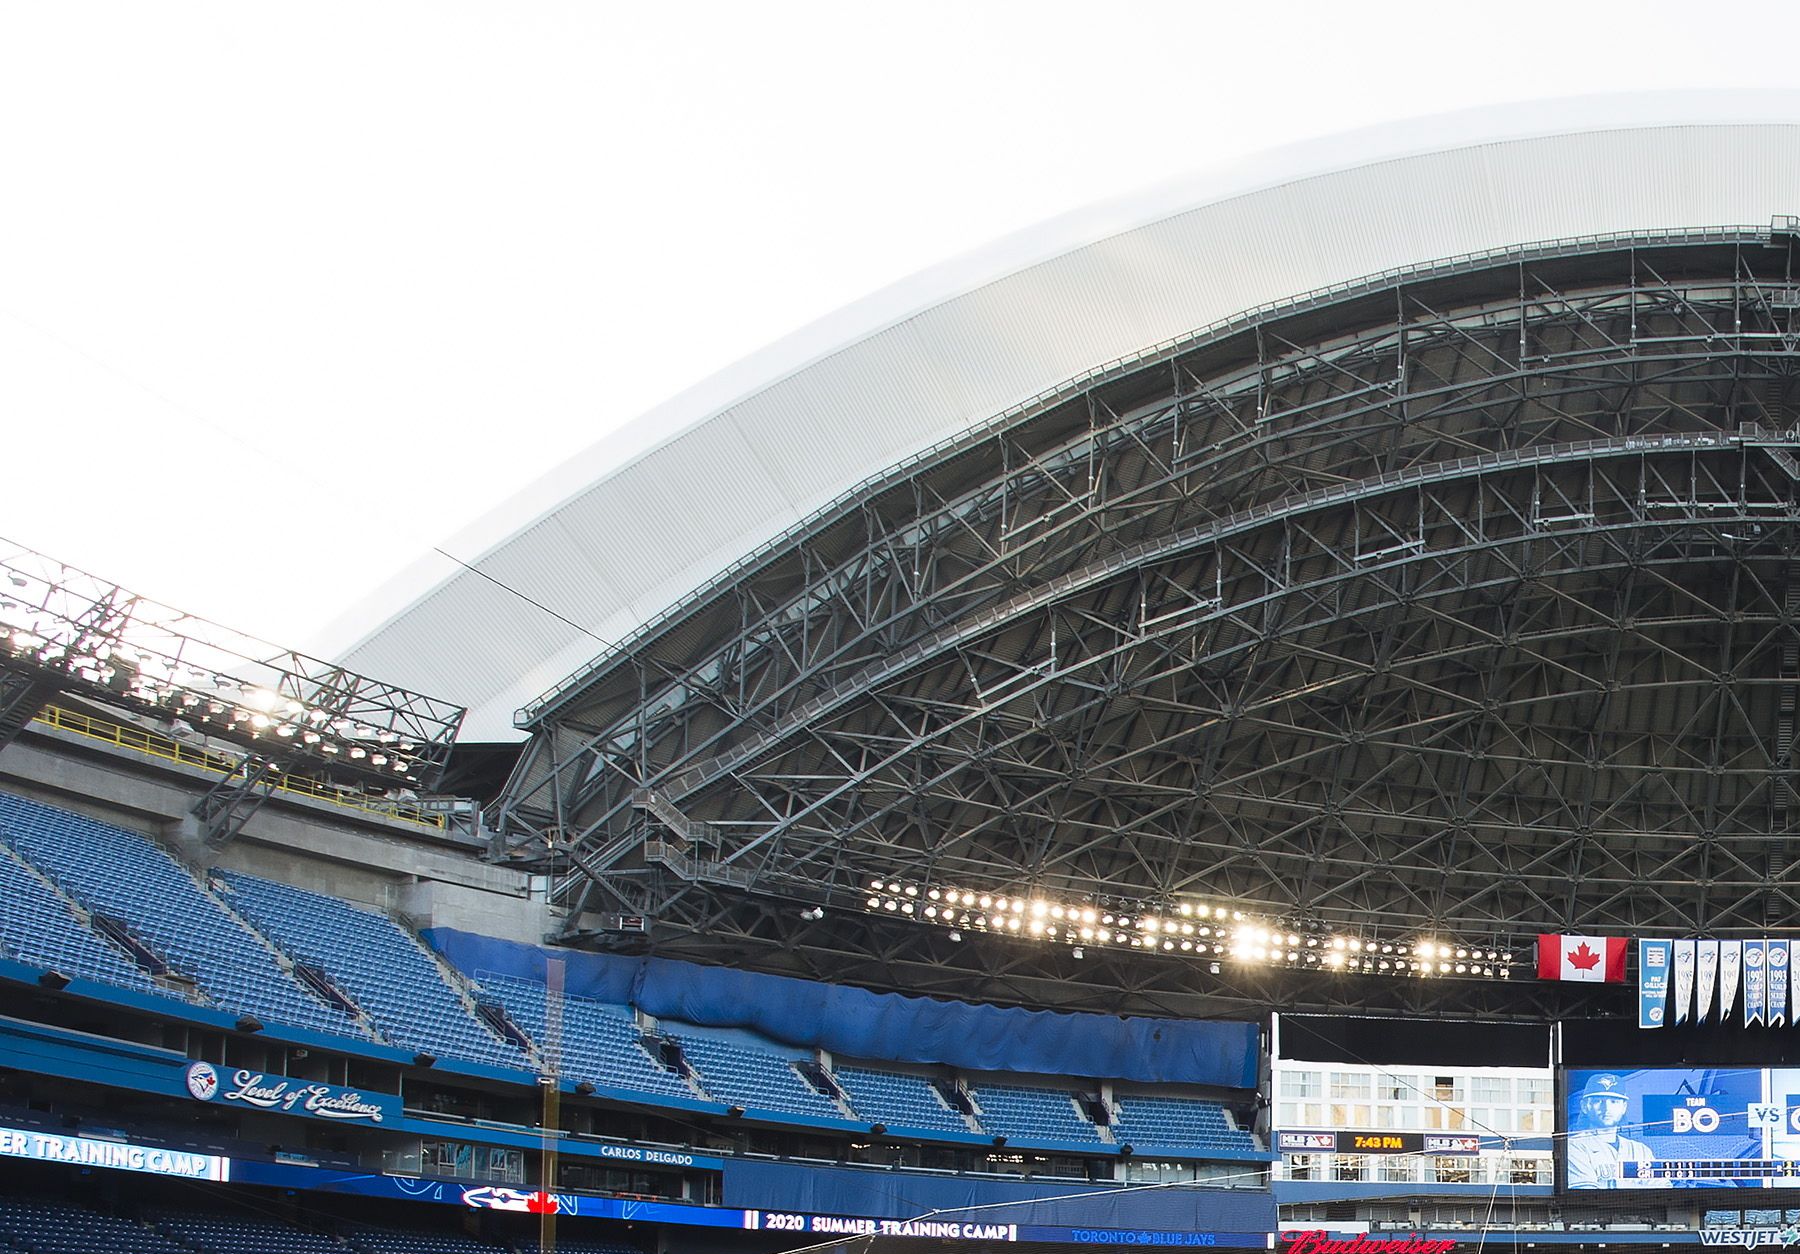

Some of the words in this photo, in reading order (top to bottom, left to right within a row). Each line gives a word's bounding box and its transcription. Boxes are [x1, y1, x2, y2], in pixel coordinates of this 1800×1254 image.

[1769, 970, 1787, 982] 1993
[225, 1069, 289, 1107] Level
[283, 1086, 308, 1110] of
[304, 1084, 384, 1123] Excellence
[1685, 1097, 1707, 1107] TEAM
[1672, 1107, 1721, 1133] BO
[1754, 1107, 1780, 1122] VS
[1354, 1136, 1381, 1149] 7:43
[1383, 1137, 1403, 1149] PM
[33, 1134, 146, 1171] TRAINING
[145, 1151, 208, 1178] CAMP
[601, 1146, 642, 1161] CARLOS
[646, 1150, 694, 1166] DELGADO
[766, 1213, 805, 1230] 2020
[812, 1216, 877, 1235] SUMMER
[879, 1220, 960, 1238] TRAINING
[962, 1223, 1008, 1240] CAMP
[1072, 1229, 1137, 1244] TORONTO
[1152, 1231, 1182, 1246] BLUE
[1184, 1232, 1216, 1246] JAYS
[1701, 1231, 1778, 1248] WESTJET
